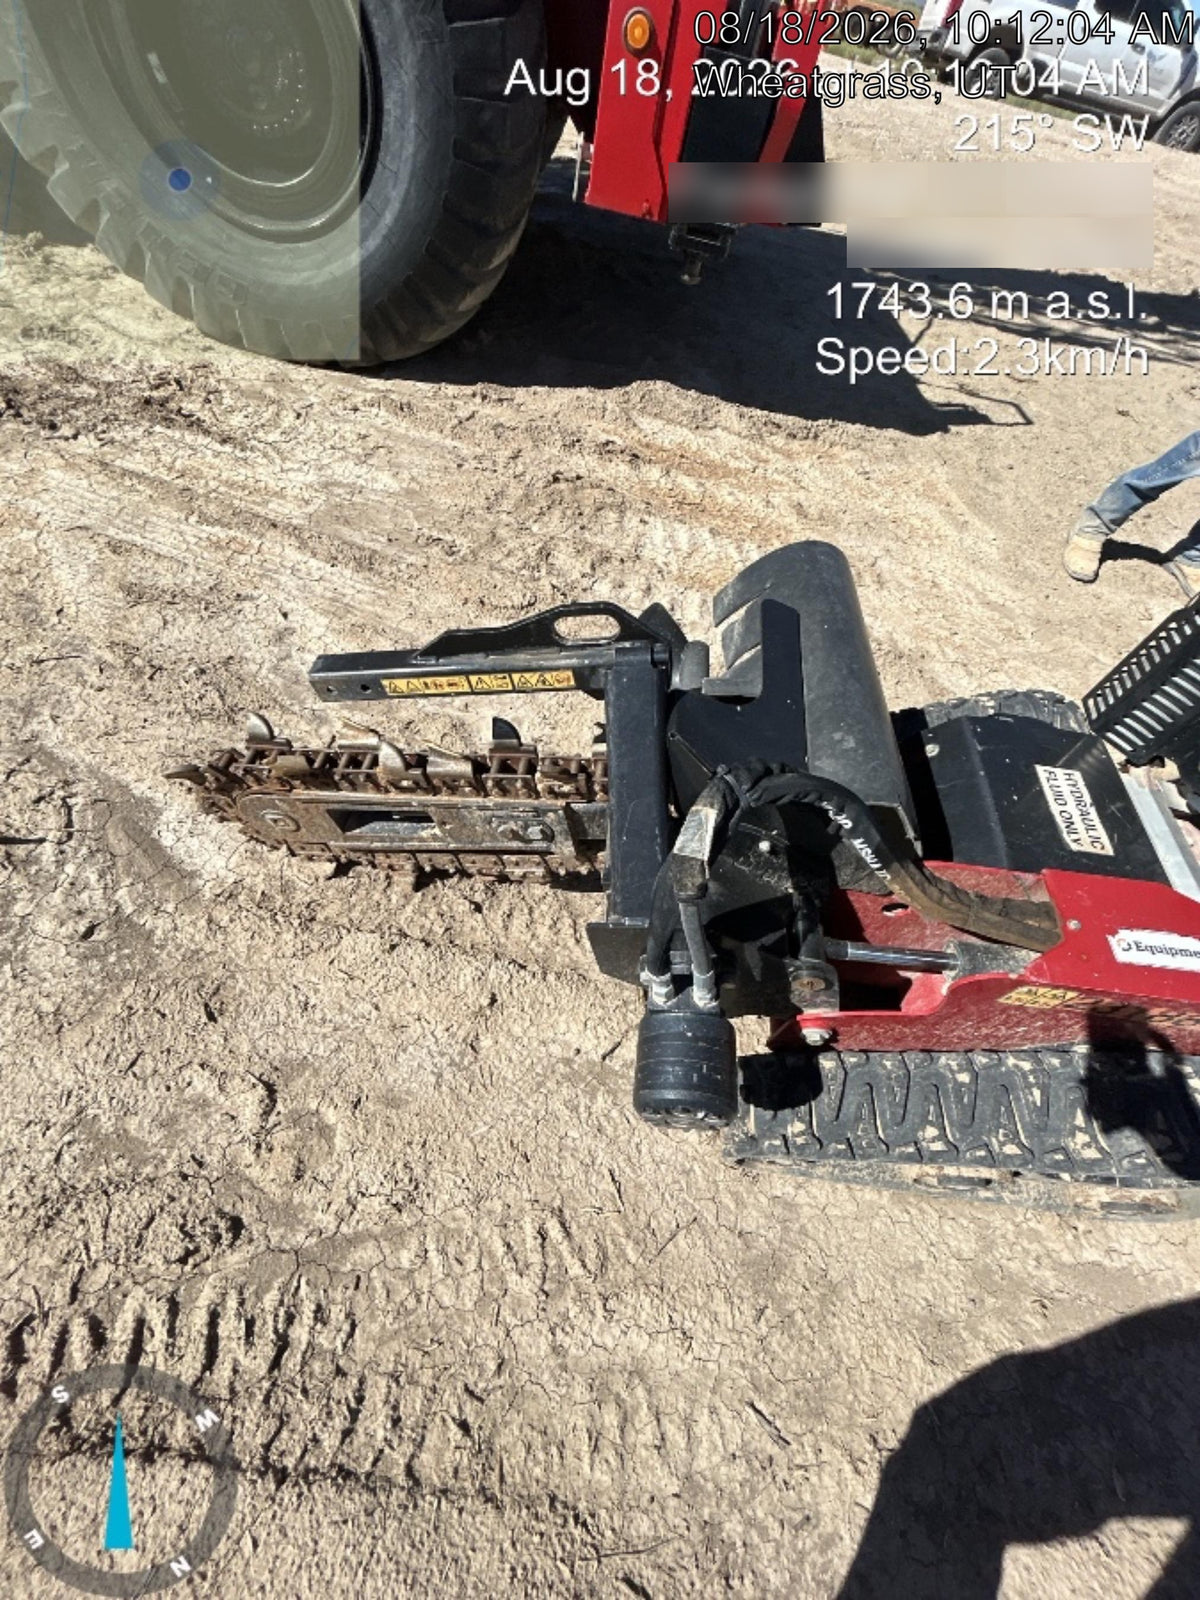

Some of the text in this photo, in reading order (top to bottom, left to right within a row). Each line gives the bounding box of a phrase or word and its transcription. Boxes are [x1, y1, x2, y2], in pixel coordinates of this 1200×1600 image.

[1043, 769, 1084, 847] FLUID ONLY
[1063, 772, 1105, 850] HYDRAULIC
